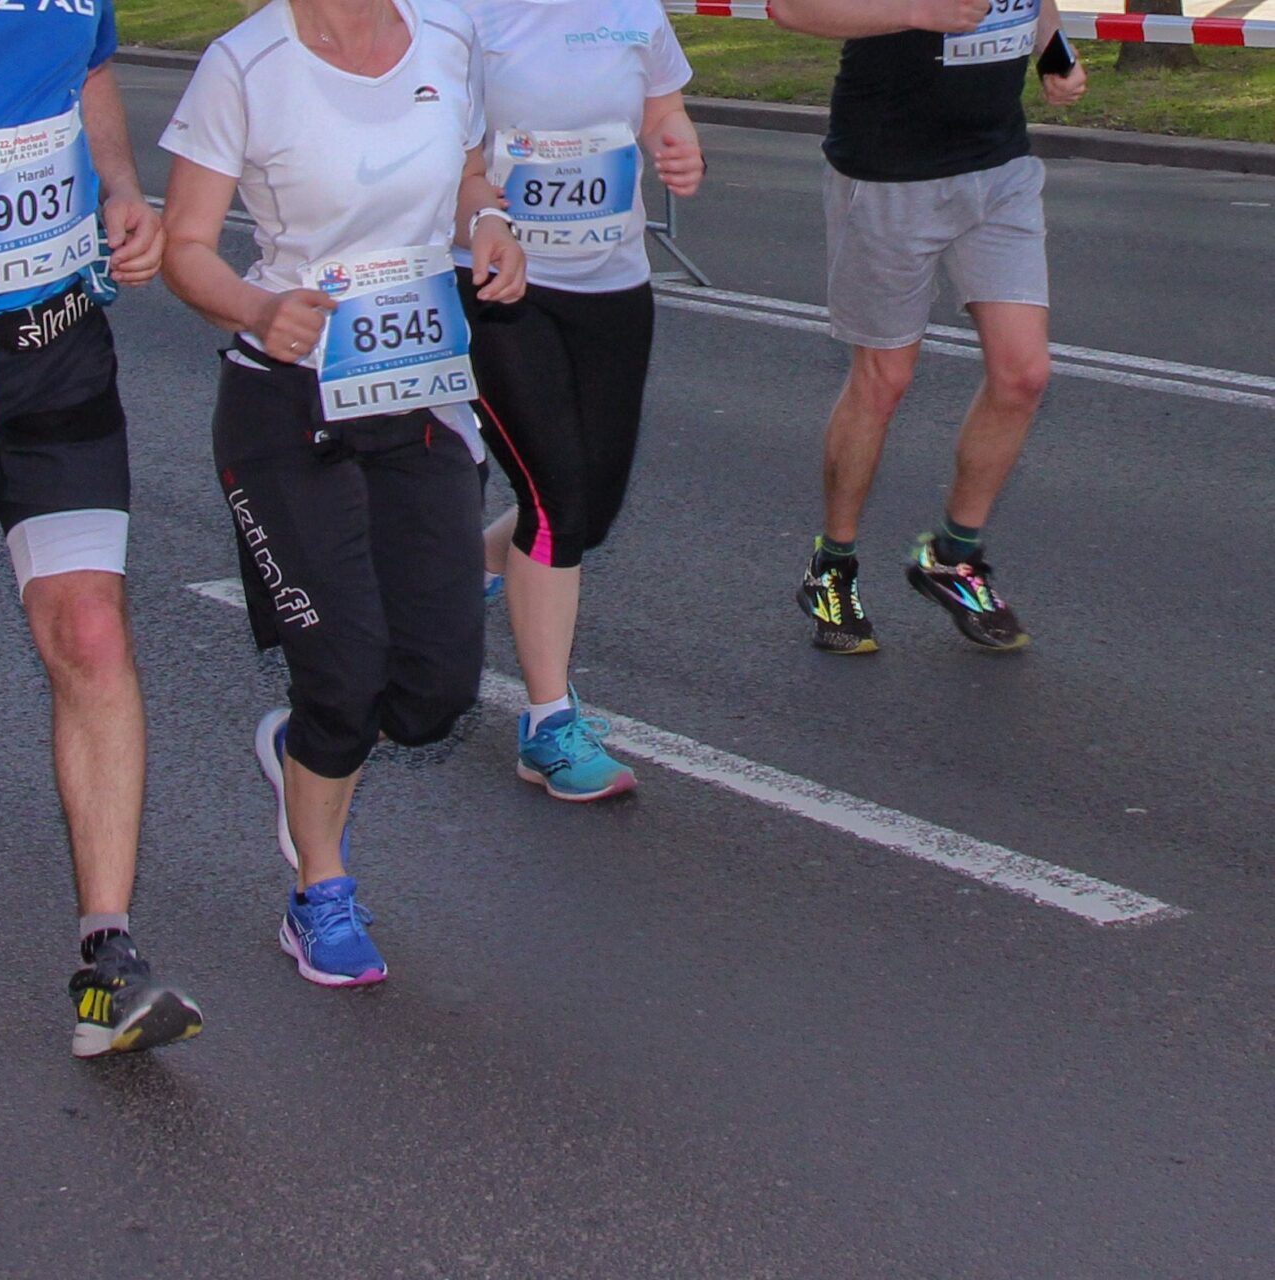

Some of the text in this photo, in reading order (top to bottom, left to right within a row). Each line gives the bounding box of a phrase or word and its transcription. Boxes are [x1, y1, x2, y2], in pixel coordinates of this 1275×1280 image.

[953, 37, 1014, 57] LINZ
[0, 139, 13, 149] 22.
[17, 165, 54, 183] Harald
[523, 177, 607, 208] 8740
[517, 225, 622, 245] INZ AG
[61, 233, 92, 268] AG
[375, 292, 420, 307] Claudia
[352, 308, 443, 353] 8545
[333, 371, 468, 409] LINZ AG
